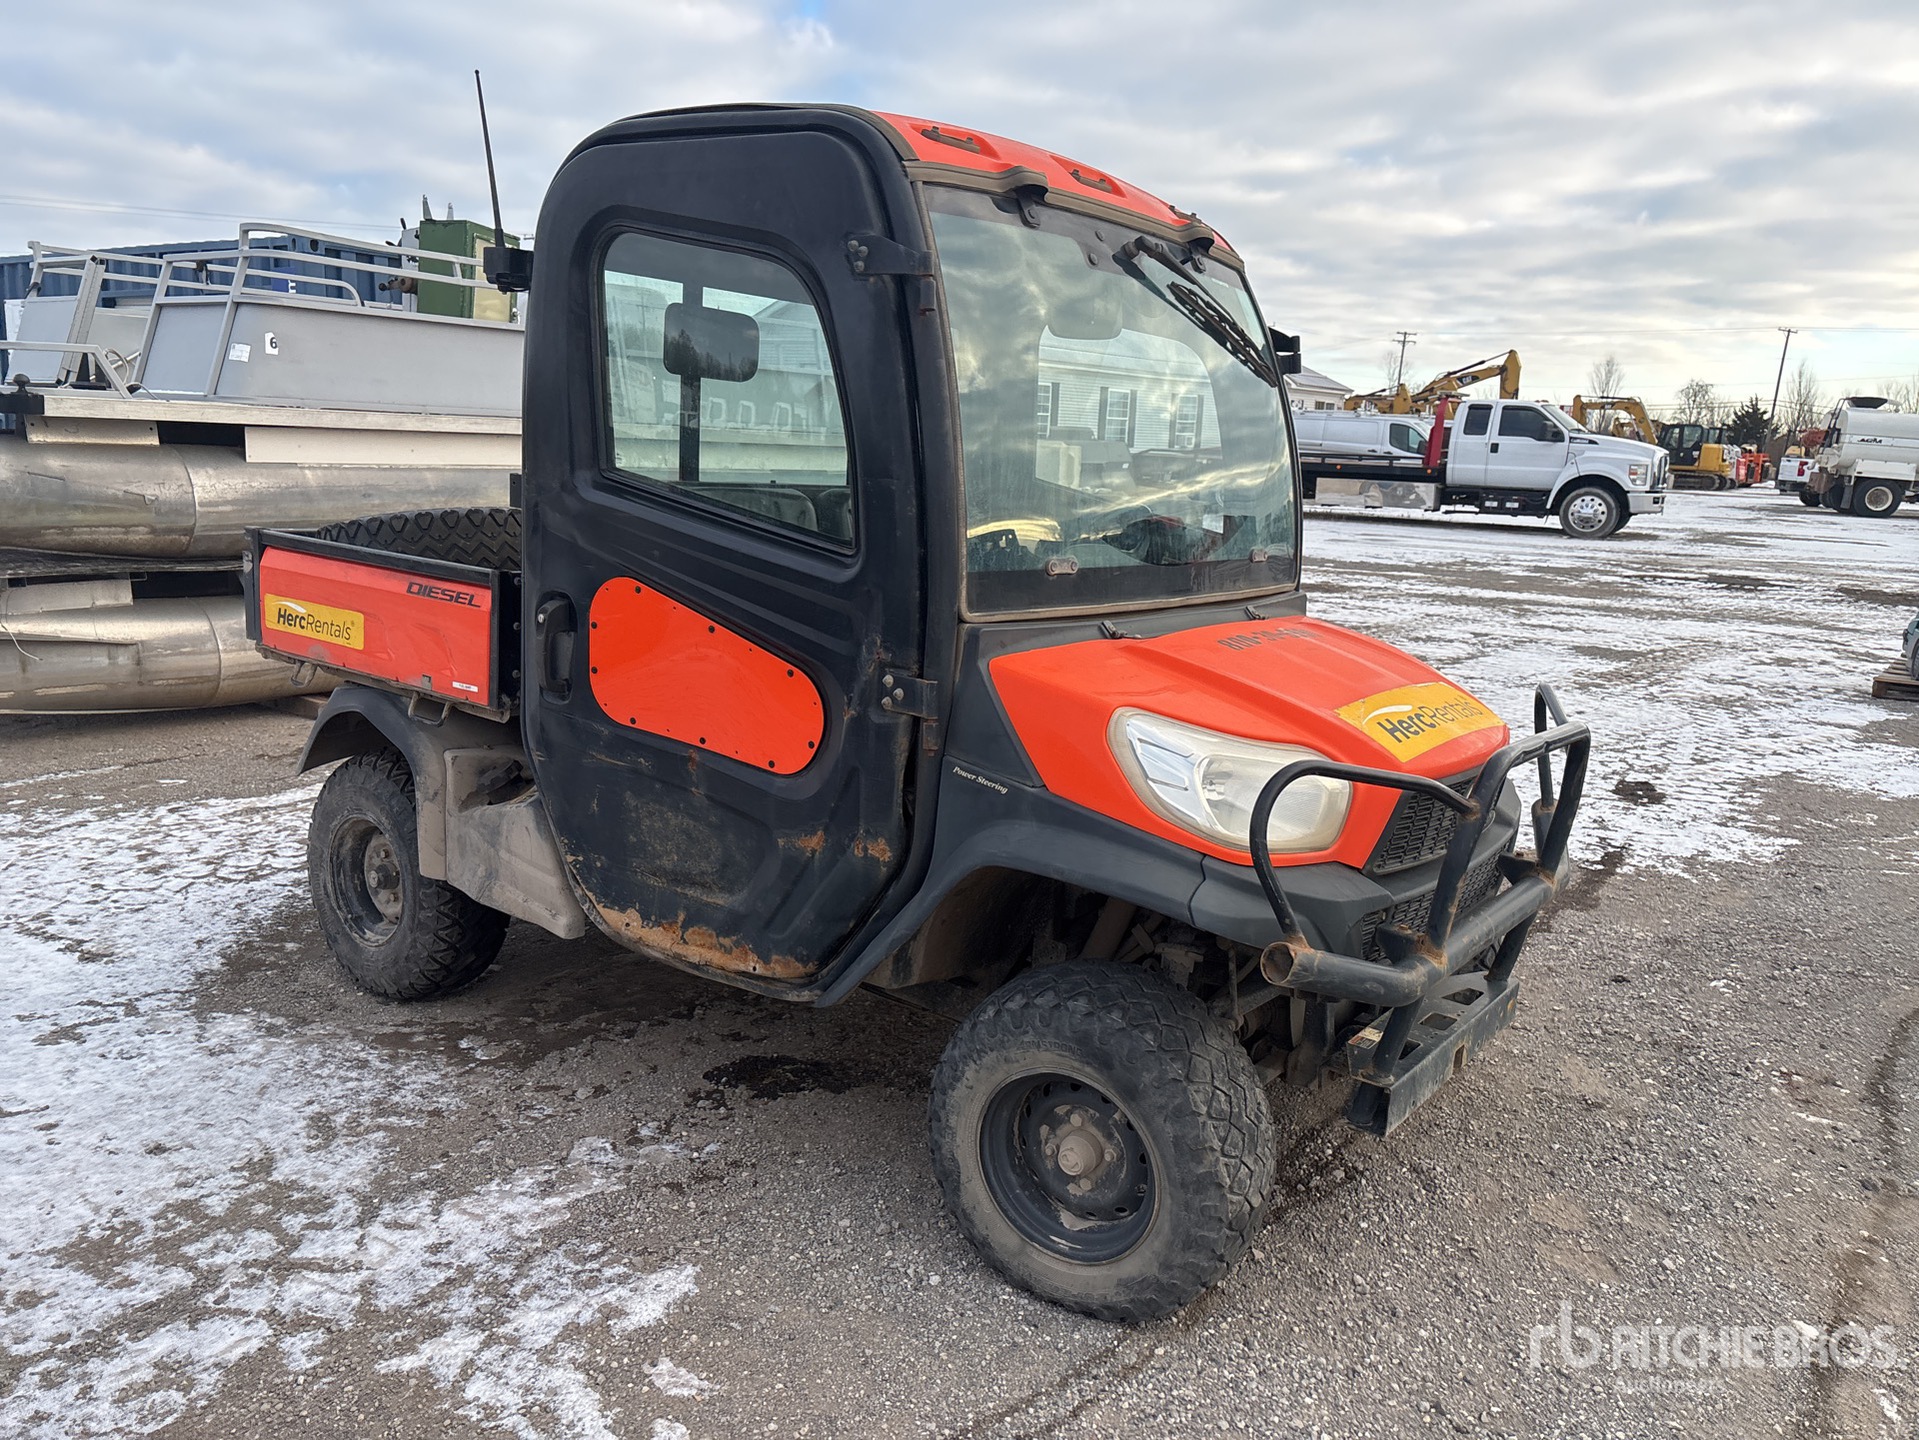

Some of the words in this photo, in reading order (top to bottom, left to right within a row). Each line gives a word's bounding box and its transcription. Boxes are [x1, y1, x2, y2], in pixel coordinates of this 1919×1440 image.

[269, 336, 278, 350] 6
[406, 581, 481, 608] DIESEL
[277, 607, 353, 641] HercRentals
[1376, 695, 1483, 744] HercRentals
[952, 766, 977, 780] Power
[975, 775, 1008, 795] Steering
